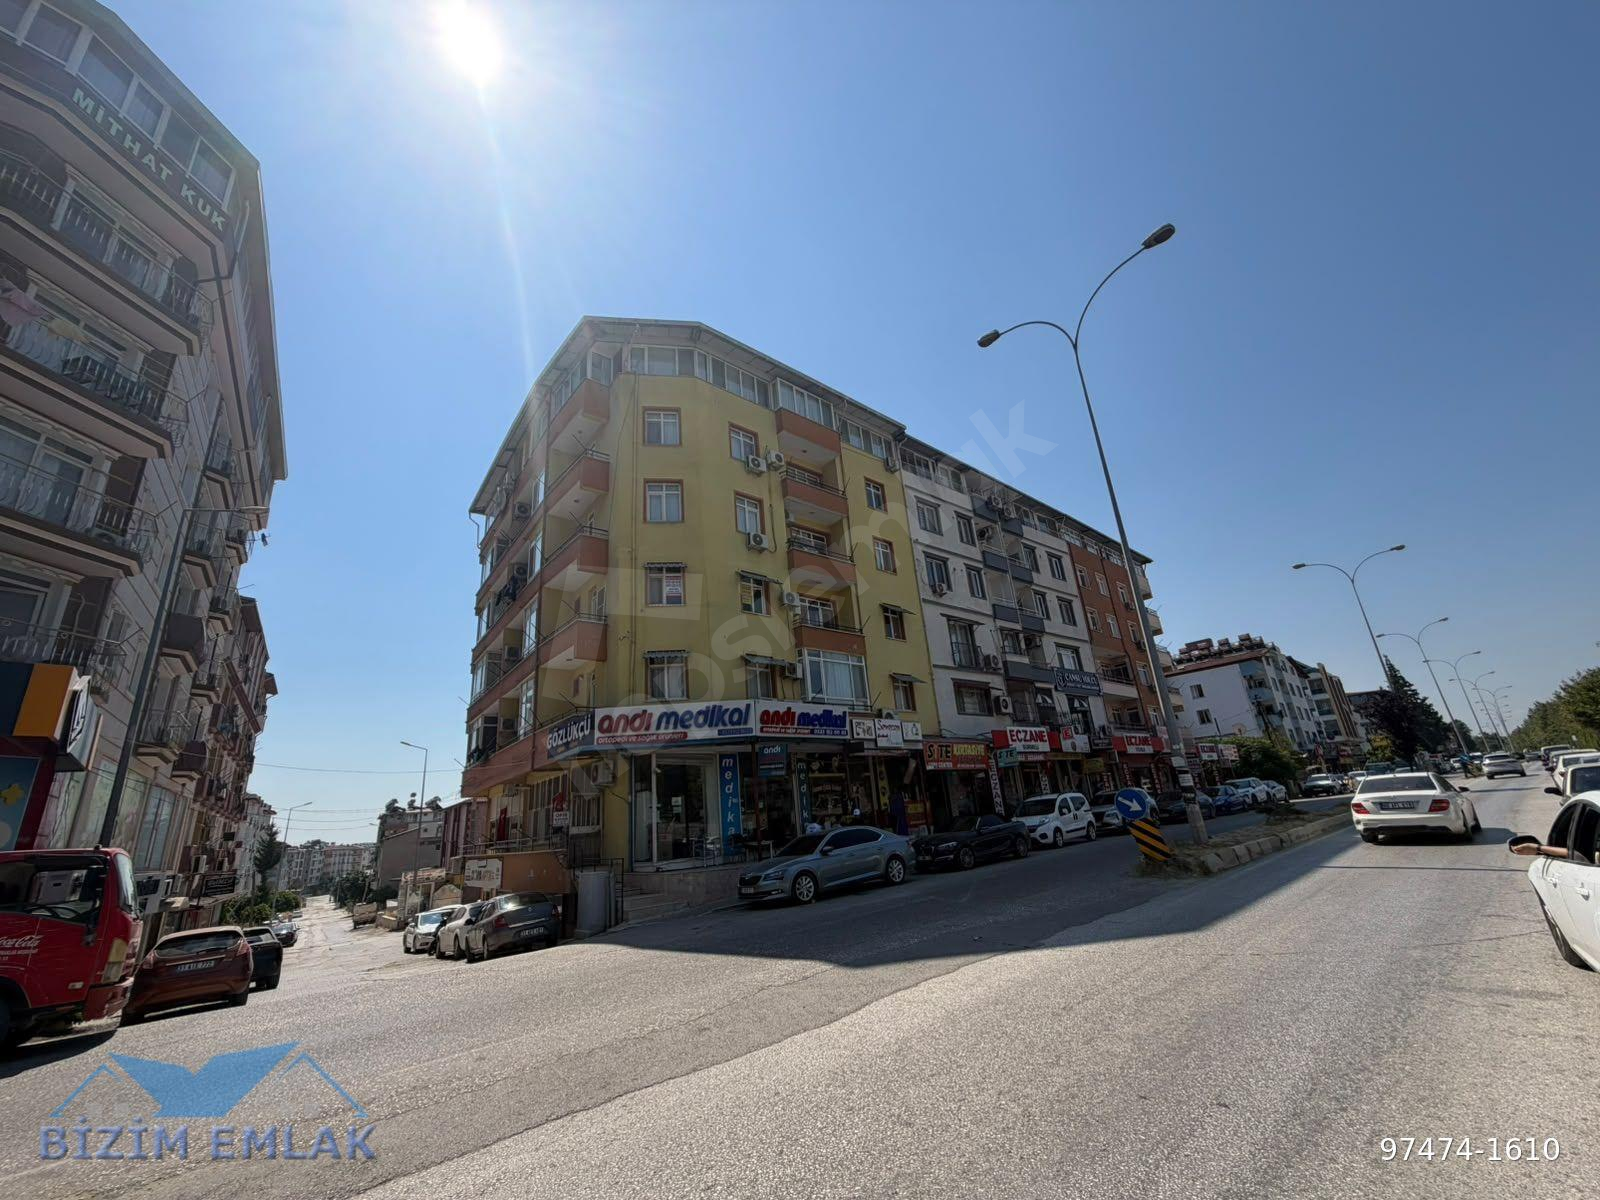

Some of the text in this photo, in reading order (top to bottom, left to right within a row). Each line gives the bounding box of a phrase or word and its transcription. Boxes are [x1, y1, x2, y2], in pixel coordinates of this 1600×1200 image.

[655, 704, 751, 731] medikal
[797, 709, 848, 728] medikal
[547, 714, 592, 749] GÖZLÜKÇÜ
[1010, 729, 1048, 743] ECZANE
